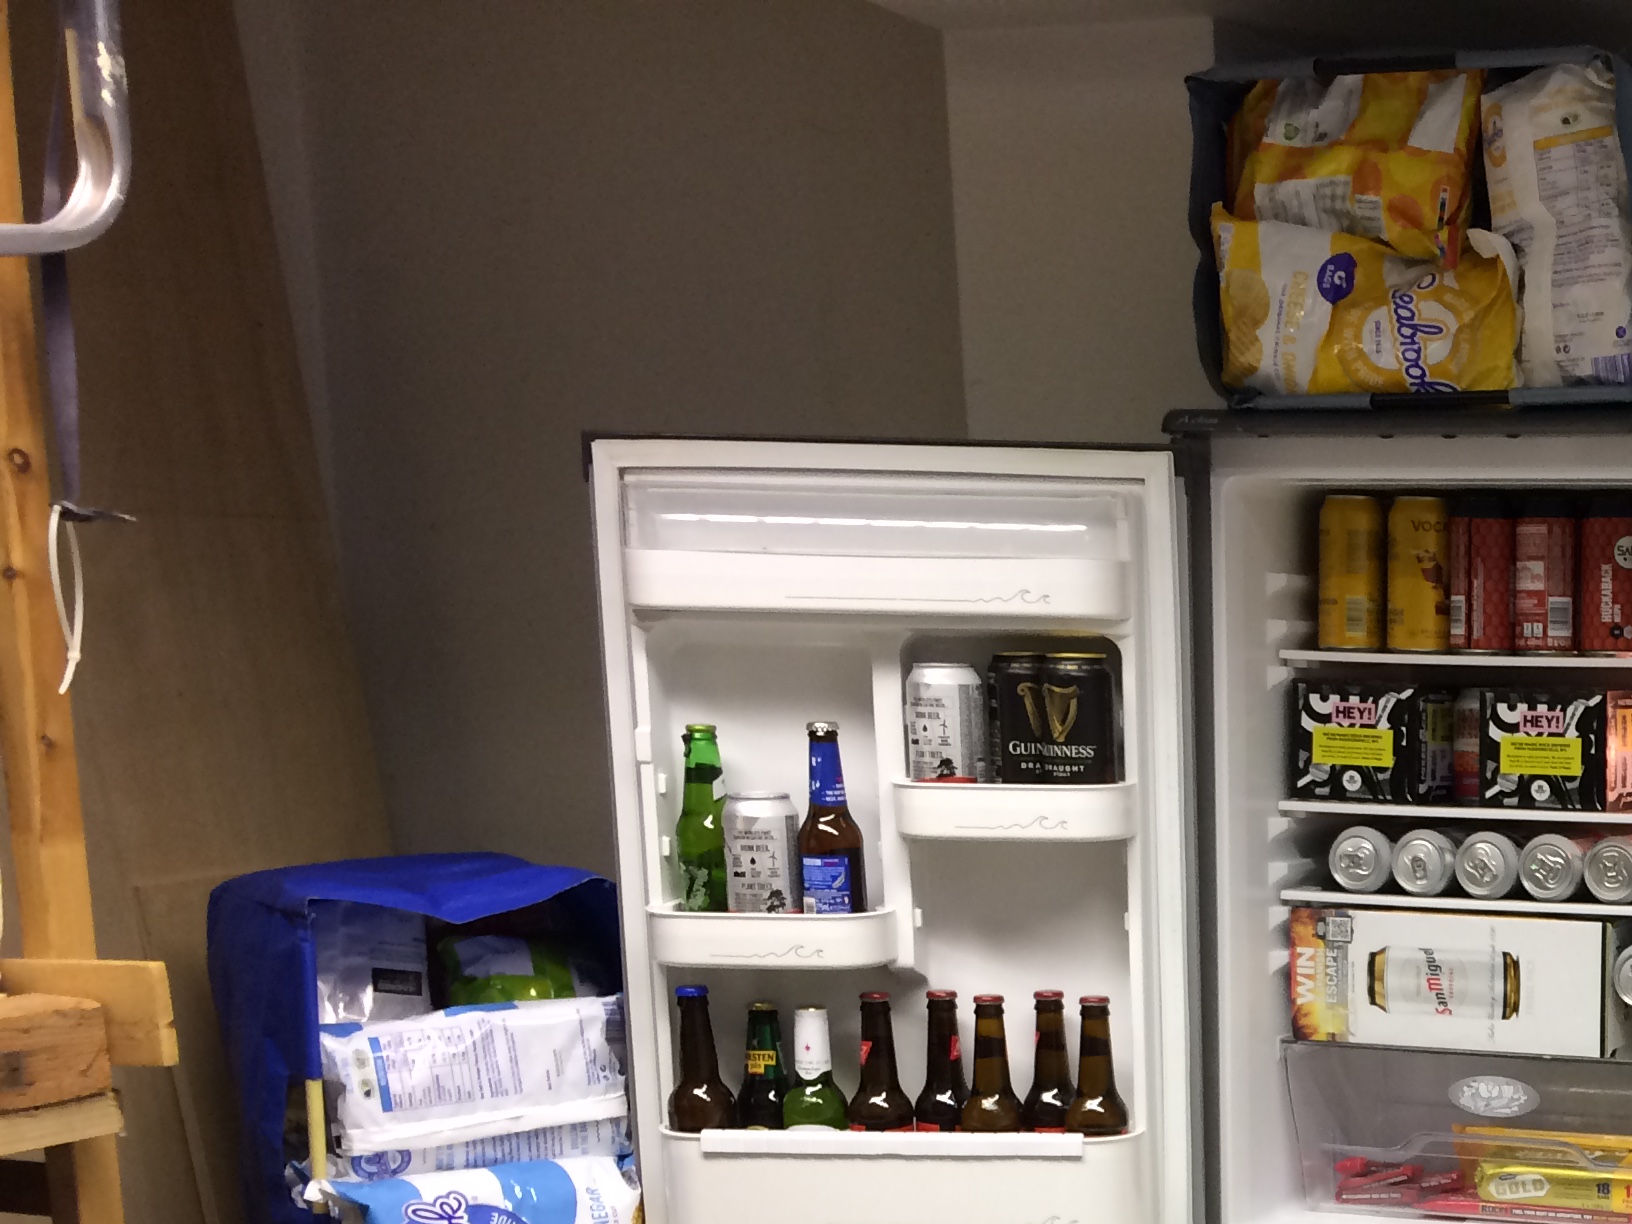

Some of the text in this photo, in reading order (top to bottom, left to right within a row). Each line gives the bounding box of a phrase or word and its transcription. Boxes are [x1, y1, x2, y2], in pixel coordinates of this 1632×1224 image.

[1600, 563, 1612, 622] HUCKABACK
[1335, 706, 1372, 721] HEY!
[1522, 714, 1560, 730] HEY!
[1296, 946, 1315, 1005] WIN
[1326, 948, 1338, 1003] ESCAPE
[1595, 1182, 1611, 1194] 18
